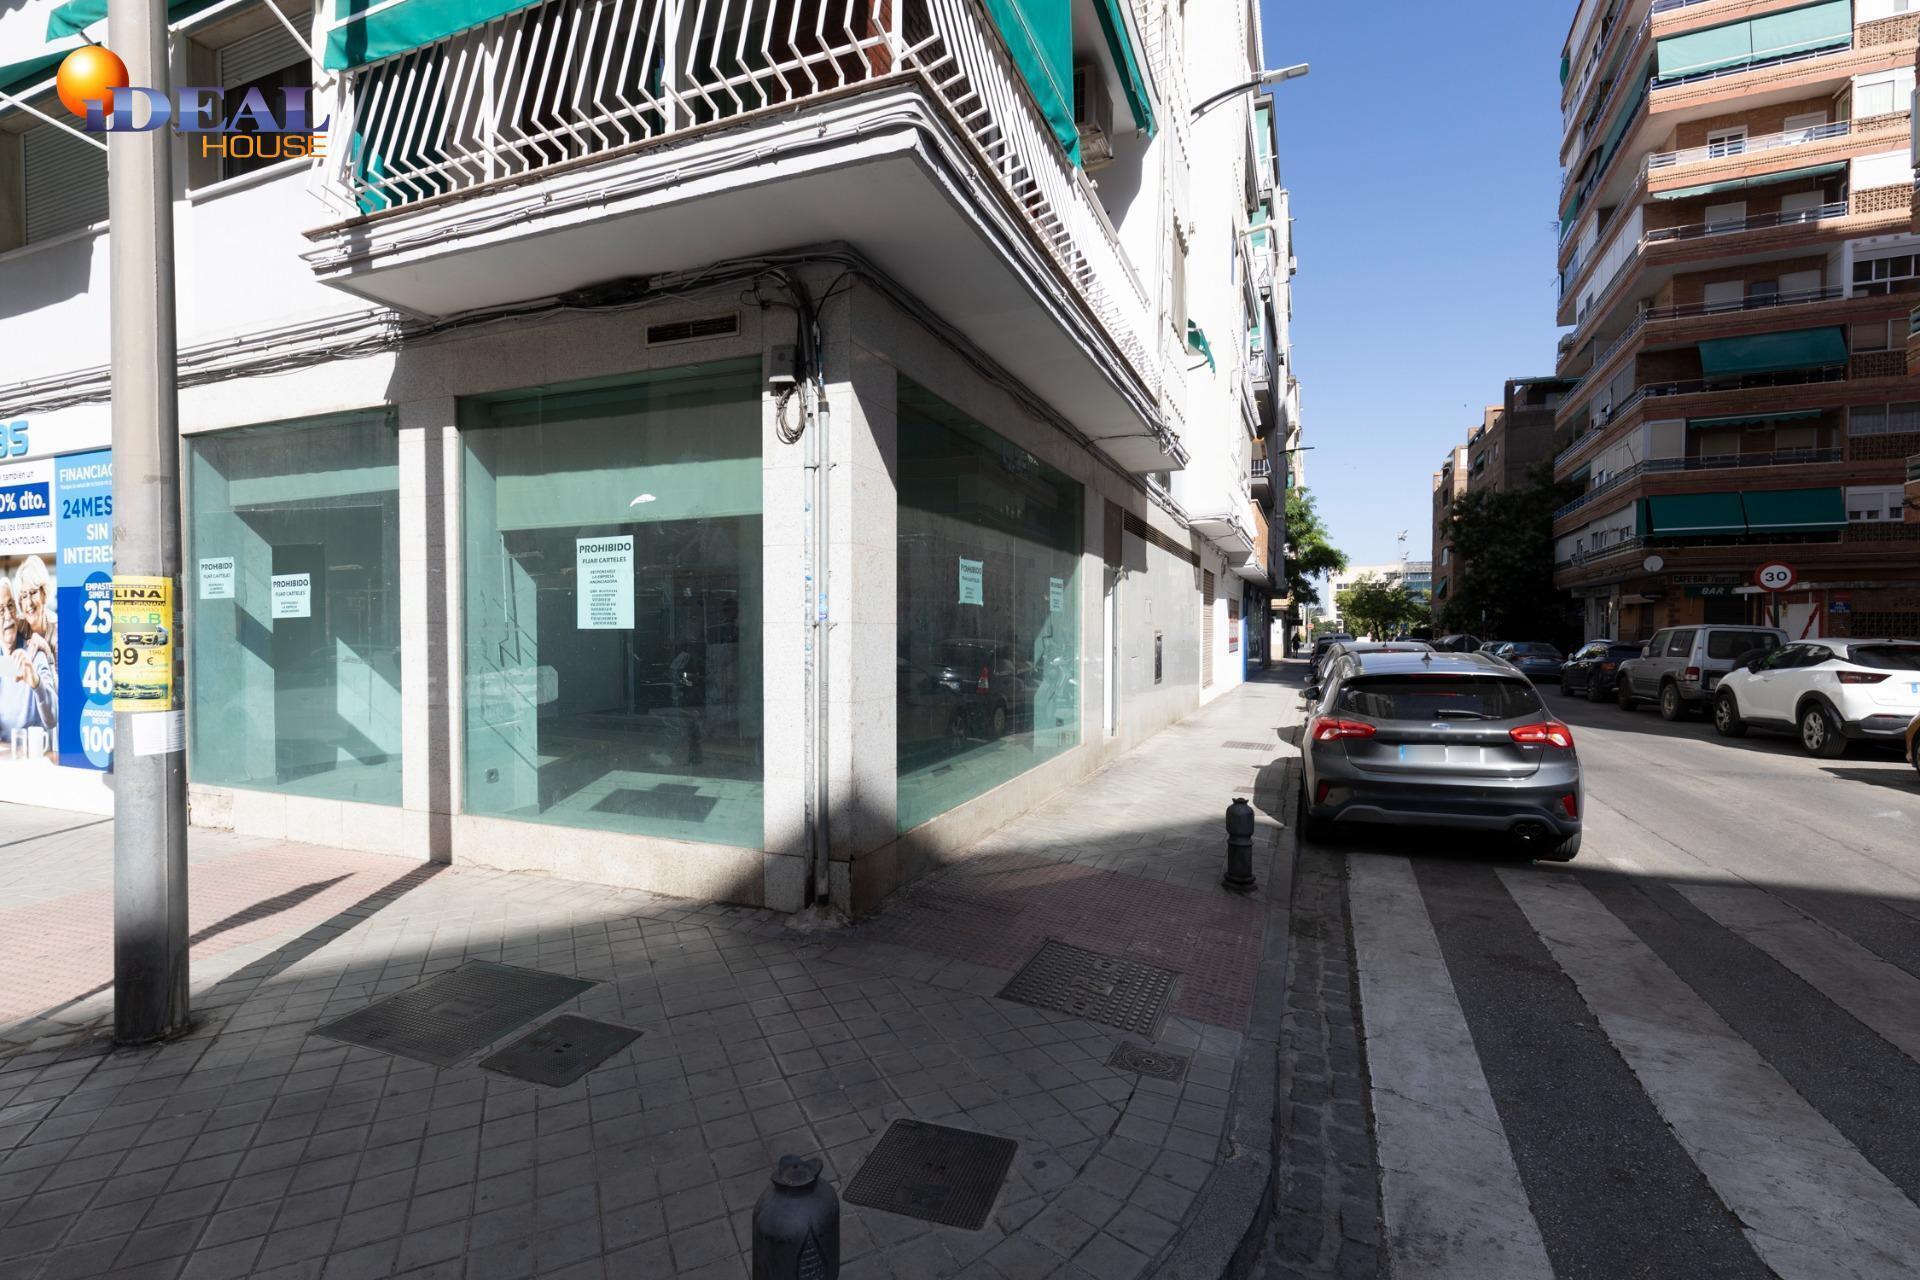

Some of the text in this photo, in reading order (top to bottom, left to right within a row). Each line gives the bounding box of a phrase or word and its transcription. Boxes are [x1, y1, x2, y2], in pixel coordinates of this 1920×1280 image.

[19, 491, 46, 510] dto.
[86, 523, 108, 540] SIN
[579, 543, 631, 553] PROHIBIDO
[201, 562, 233, 570] PROHIBIDO
[1765, 571, 1787, 582] 30
[273, 579, 309, 588] PROHIBIDO
[88, 591, 110, 599] SIMPLE
[115, 590, 161, 599] LINA
[1701, 587, 1725, 595] BAR
[82, 660, 113, 694] 48
[82, 726, 114, 753] 100
